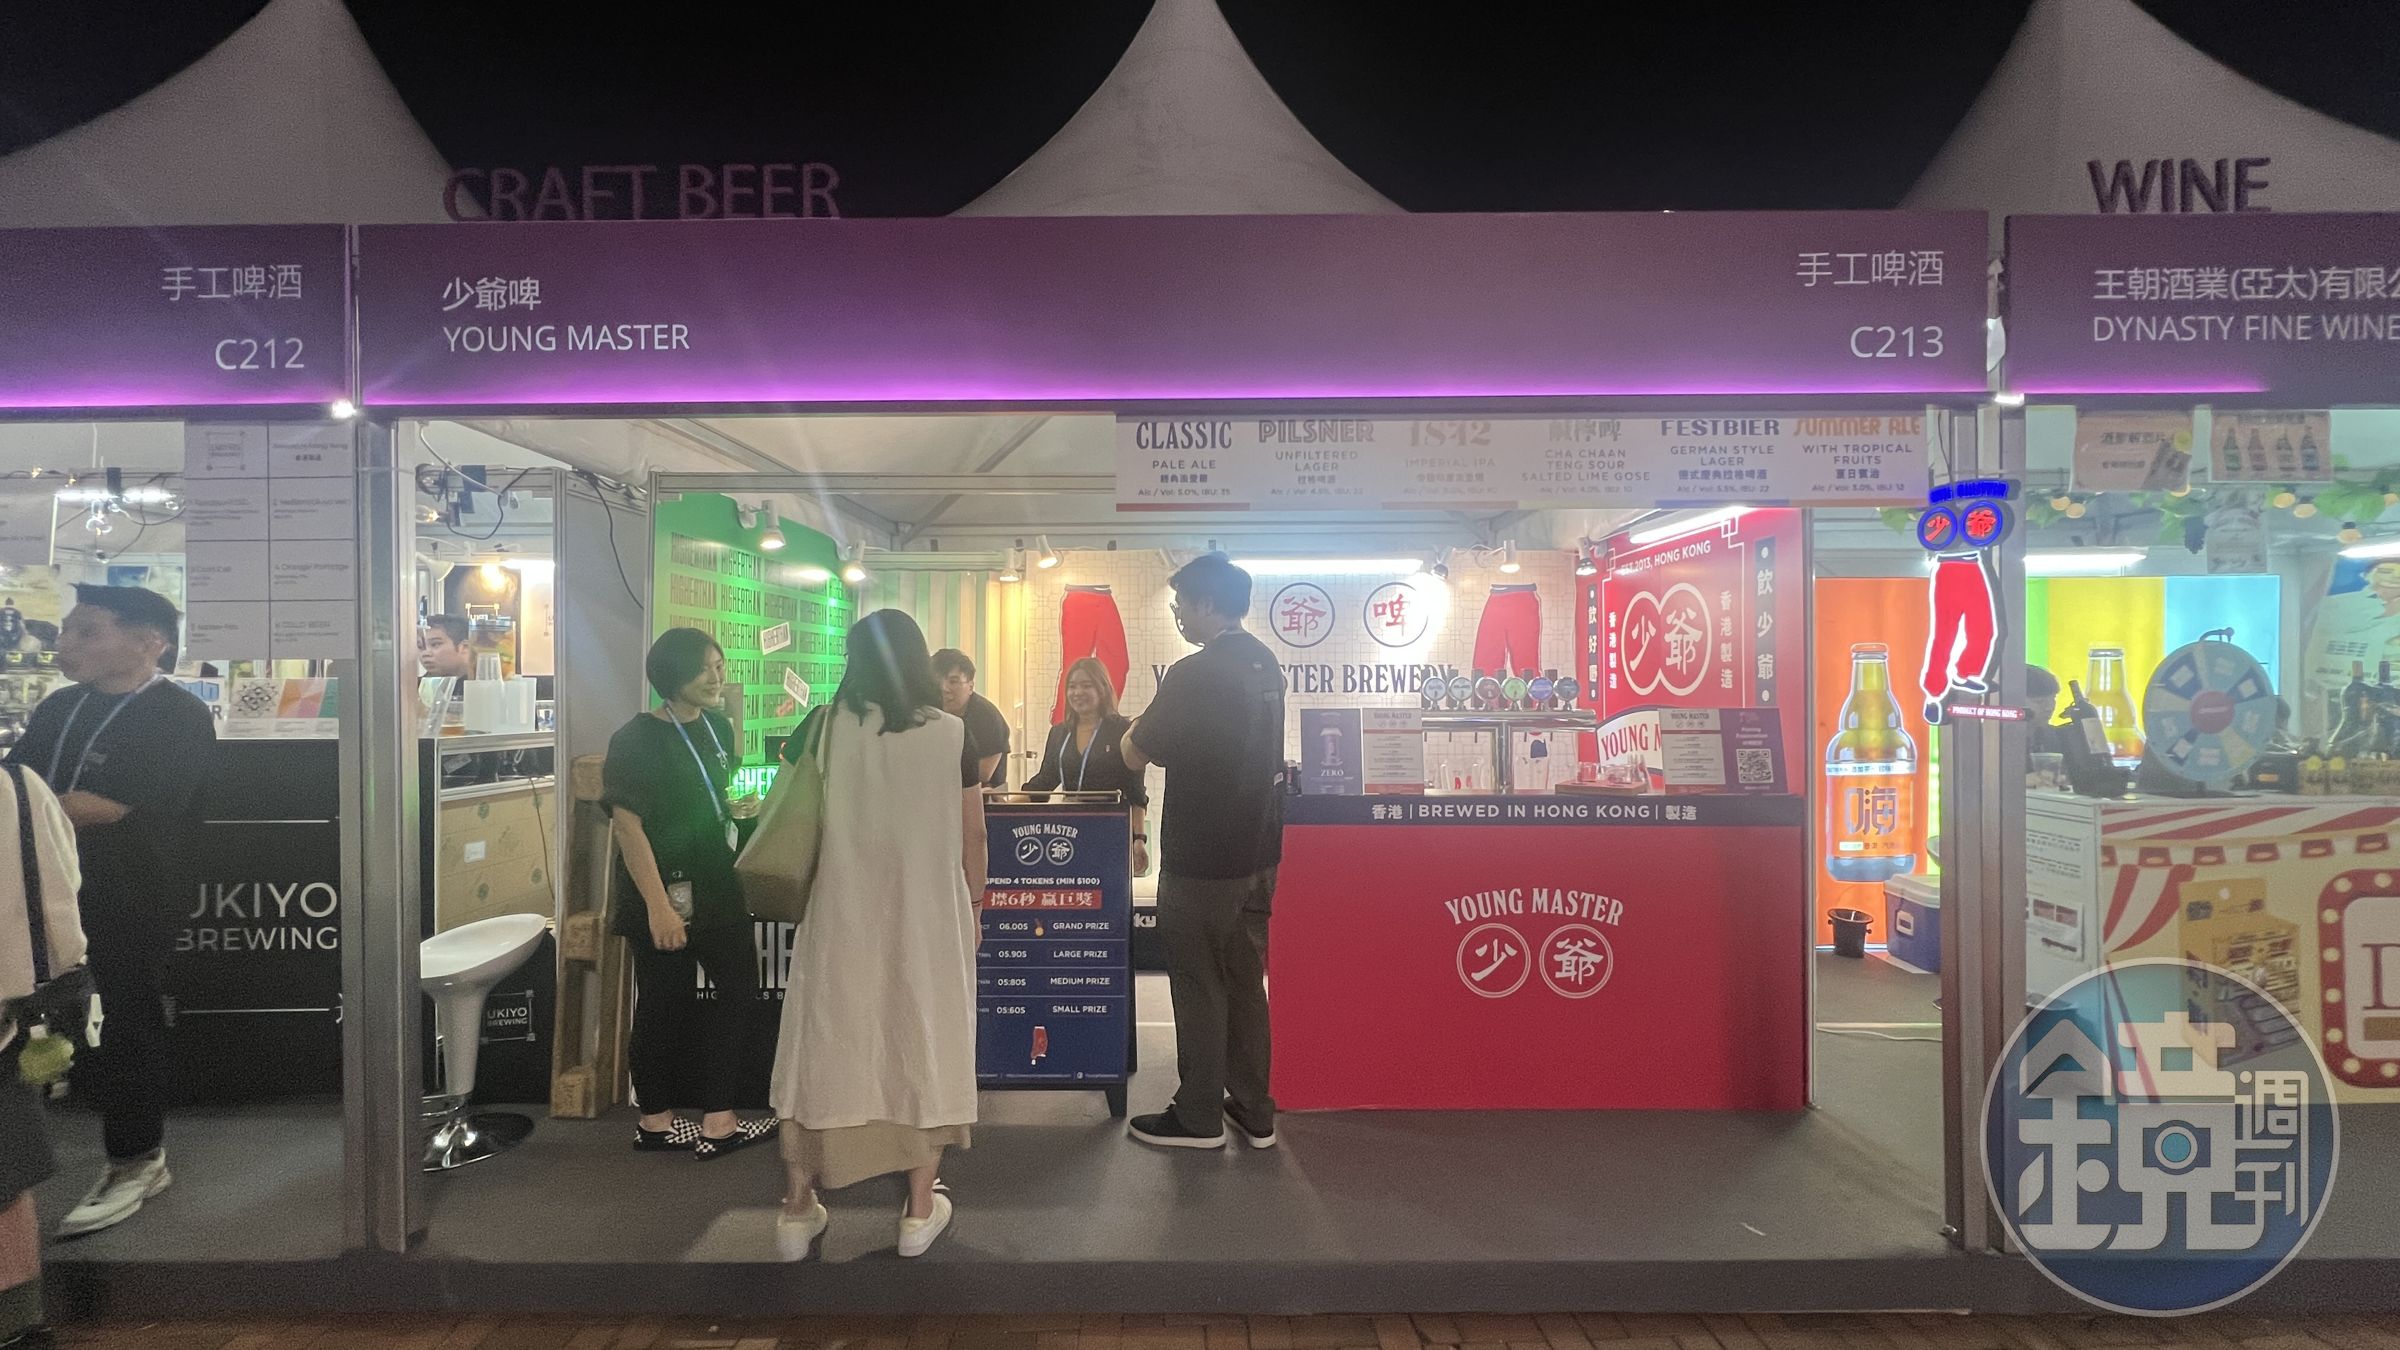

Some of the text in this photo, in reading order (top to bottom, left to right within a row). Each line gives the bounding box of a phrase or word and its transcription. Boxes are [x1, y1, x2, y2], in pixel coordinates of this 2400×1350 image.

[443, 163, 841, 222] CRAFT BEER
[2087, 157, 2271, 213] WINE
[1796, 250, 1944, 287] 手工啤酒
[161, 264, 303, 301] 手工啤酒
[442, 277, 542, 312] 少爺啤
[2093, 315, 2235, 342] DYNASTY
[2245, 315, 2312, 341] FINE
[443, 323, 690, 352] YOUNG MASTER
[1850, 325, 1944, 358] C213
[215, 337, 305, 370] C212
[1258, 419, 1378, 443] PILSNER
[1660, 418, 1781, 436] FESTBIER
[1793, 415, 1921, 437] SUMMER ALE
[1136, 421, 1232, 450] CLASSIC
[1275, 450, 1359, 461] UNFILTERED
[1545, 448, 1626, 459] CHA CHAAN
[1670, 445, 1776, 455] GERMAN STYLE
[1802, 443, 1913, 454] WITH TROPICAL
[1152, 459, 1217, 470] PALE ALE
[1294, 462, 1340, 473] LAGER
[1546, 460, 1626, 471] TENG SOUR
[1700, 456, 1745, 466] LAGER
[1833, 455, 1882, 465] FRUITS
[1521, 471, 1651, 482] SALTED LIME GOSE
[1654, 548, 1680, 567] HONG
[1682, 540, 1711, 559] KONG
[1757, 570, 1773, 681] 飲少爺
[1601, 723, 1649, 761] YOUNG
[1320, 768, 1344, 778] ZERO
[1371, 803, 1403, 820] 香港
[1418, 803, 1650, 818] BREWED IN HONG KONG
[1664, 804, 1697, 820] 製造
[1012, 823, 1078, 839] YOUNG MASTER
[1013, 877, 1019, 885] 4
[1021, 877, 1054, 885] TOKENS
[1056, 877, 1075, 886] (MIN
[1077, 877, 1101, 886] $100)
[1445, 887, 1624, 927] YOUNG MASTER
[1053, 922, 1084, 931] GRAND
[1086, 922, 1110, 931] PRIZE
[1053, 950, 1082, 959] LARGE
[1084, 950, 1108, 959] PRIZE
[1471, 938, 1604, 986] 少爺
[1050, 977, 1084, 986] MEDIUM
[1085, 977, 1110, 986] PRIZE
[487, 1007, 527, 1020] UKIYO
[1052, 1005, 1080, 1014] SMALL
[1082, 1005, 1107, 1014] PRIZE
